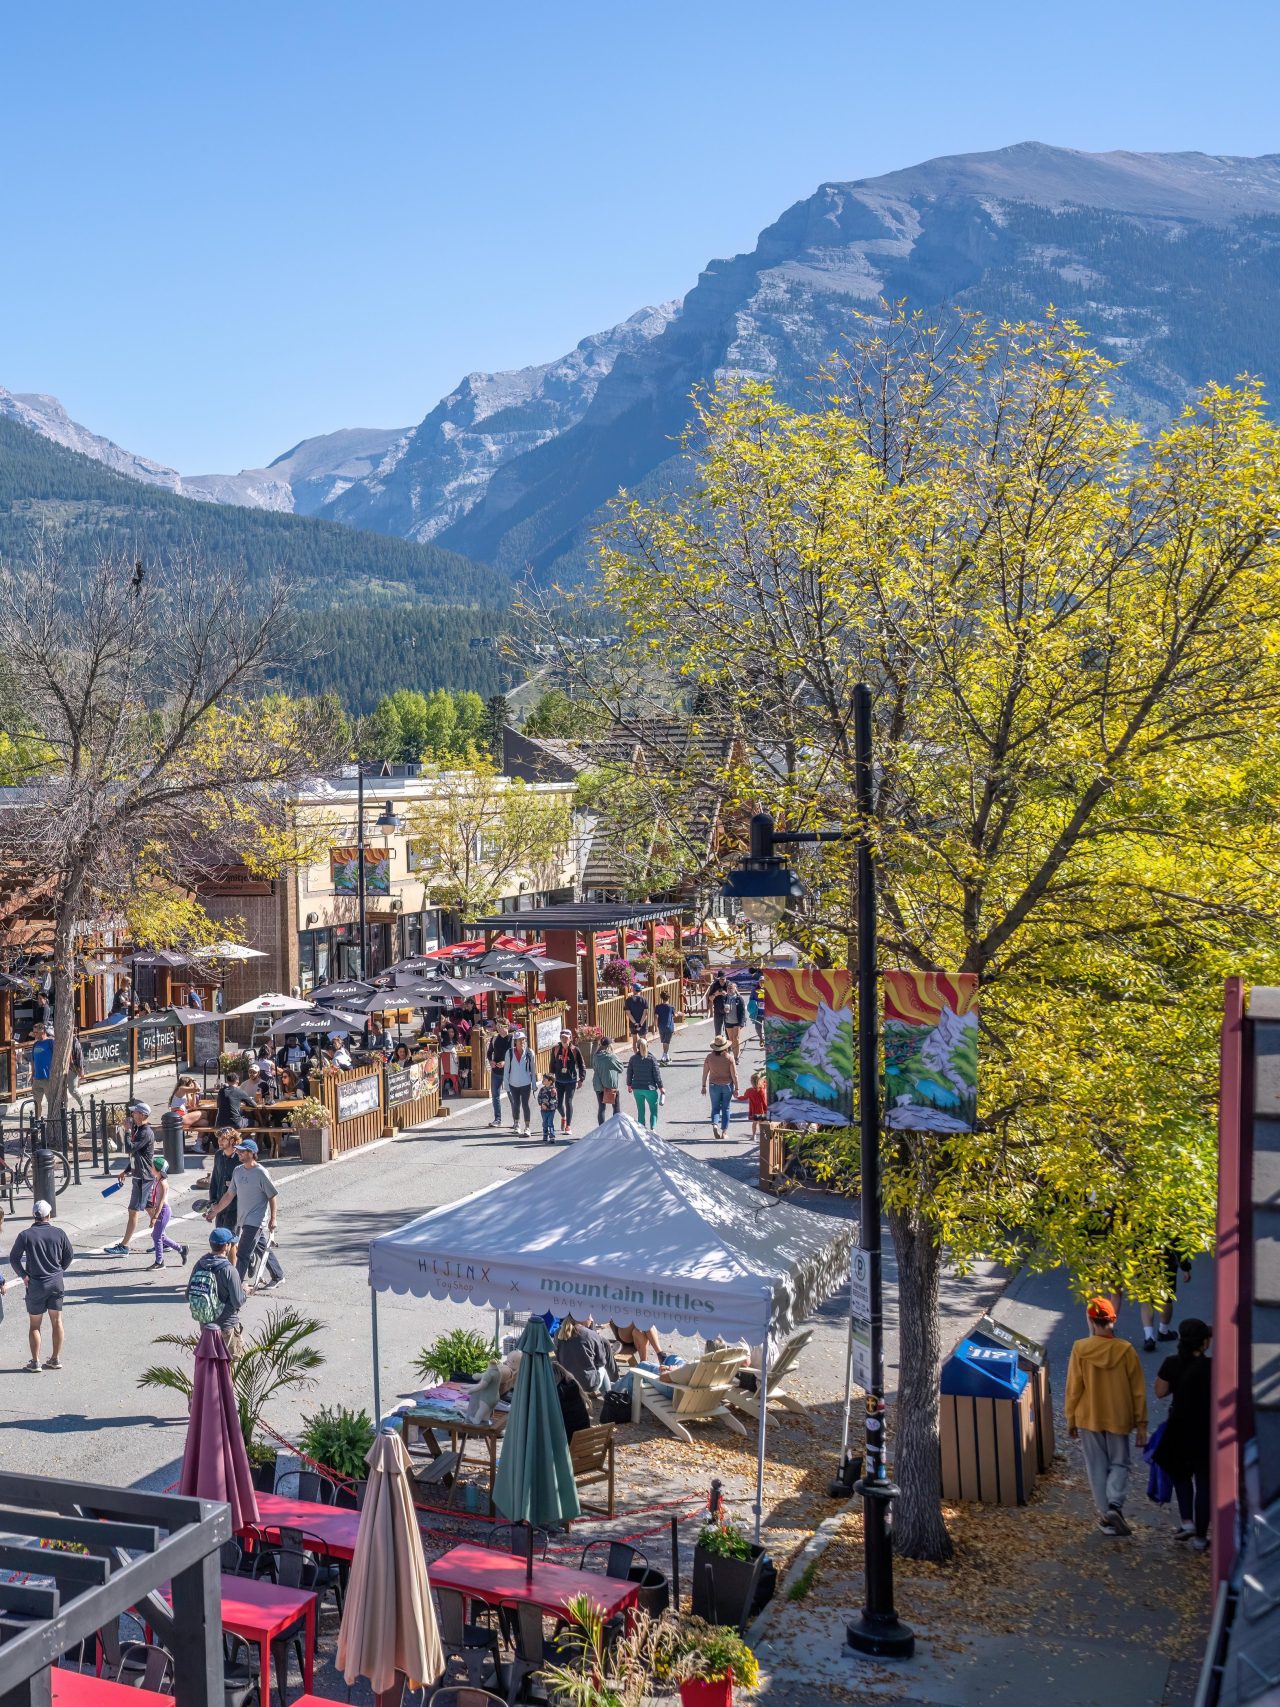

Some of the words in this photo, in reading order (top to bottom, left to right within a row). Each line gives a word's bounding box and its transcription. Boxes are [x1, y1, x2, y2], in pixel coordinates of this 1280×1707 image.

[88, 1043, 120, 1061] LOUNGE
[143, 1031, 175, 1049] PASTRIES
[418, 1258, 490, 1282] HIJINX
[540, 1277, 644, 1304] mountain
[652, 1288, 716, 1313] littles
[553, 1296, 583, 1308] BABY
[601, 1303, 632, 1315] KIDS
[635, 1308, 700, 1324] BOUTIQUE
